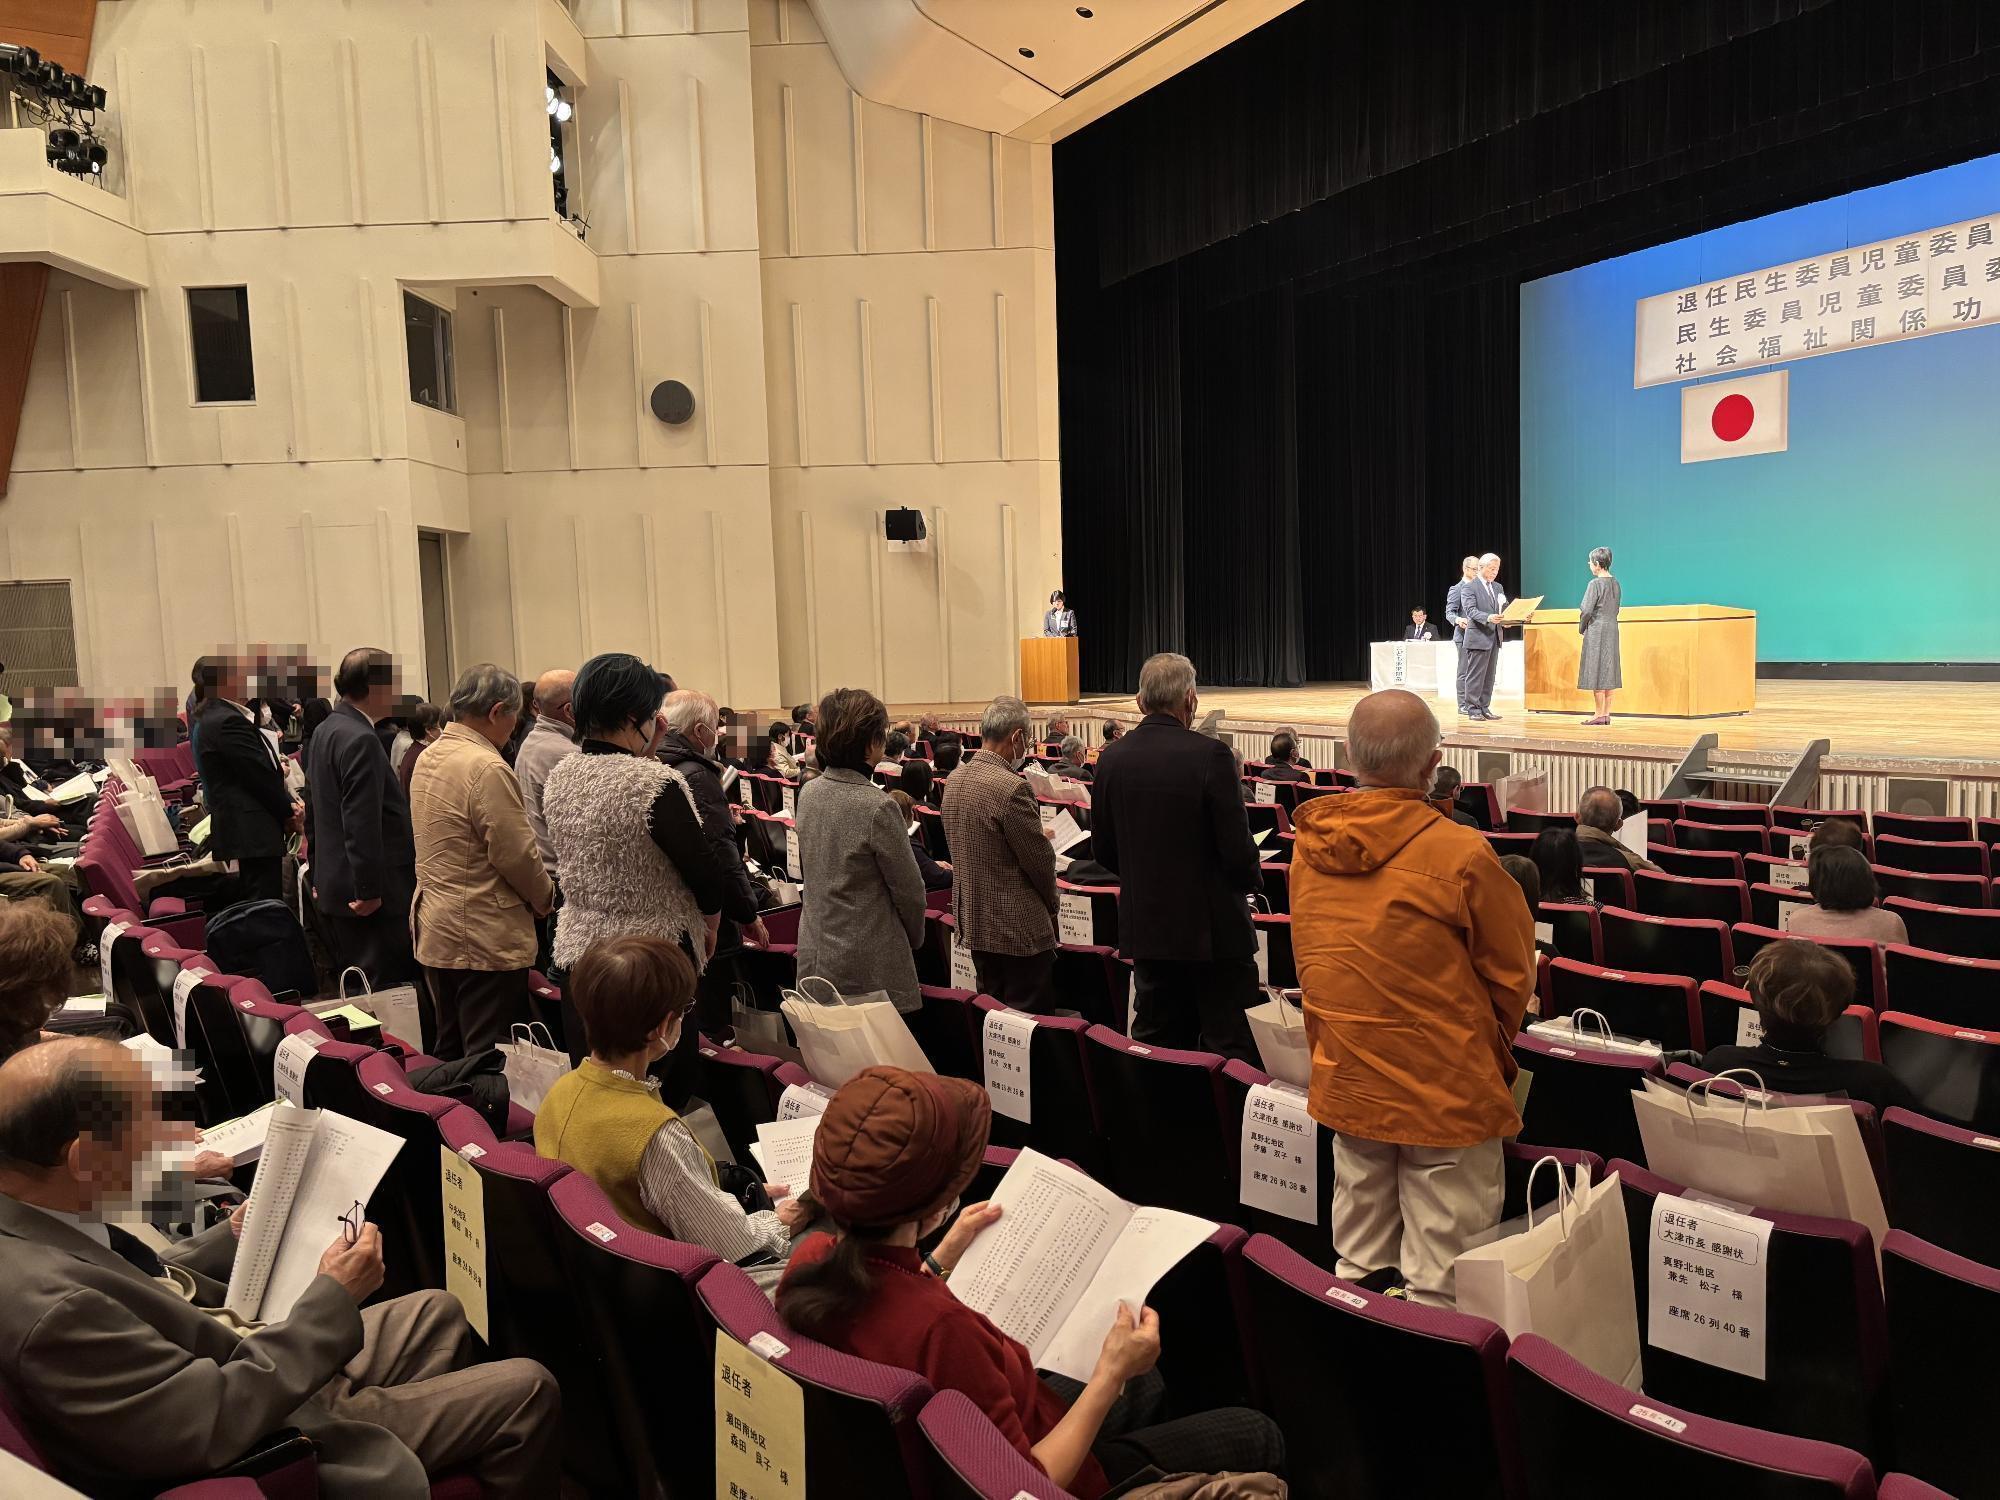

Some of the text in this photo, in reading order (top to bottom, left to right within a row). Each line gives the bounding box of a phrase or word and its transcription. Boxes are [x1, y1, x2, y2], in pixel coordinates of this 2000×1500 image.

[1677, 222, 1994, 315] 退任民生委員児童委員
[1675, 297, 1981, 375] 社会福祉関係功
[1253, 1098, 1275, 1112] 退任者
[1252, 1110, 1303, 1133] 大津市長 感謝状
[1250, 1131, 1285, 1149] 真野北地区
[1664, 1212, 1699, 1231] 退任者
[1663, 1229, 1744, 1260] 大津市長 感謝状
[1663, 1255, 1715, 1279] 真野北地区
[1667, 1271, 1744, 1301] 兼先 松子 様
[721, 1363, 752, 1399] 退任者
[725, 1410, 767, 1450] 瀬田南地区
[730, 1433, 747, 1454] 森田
